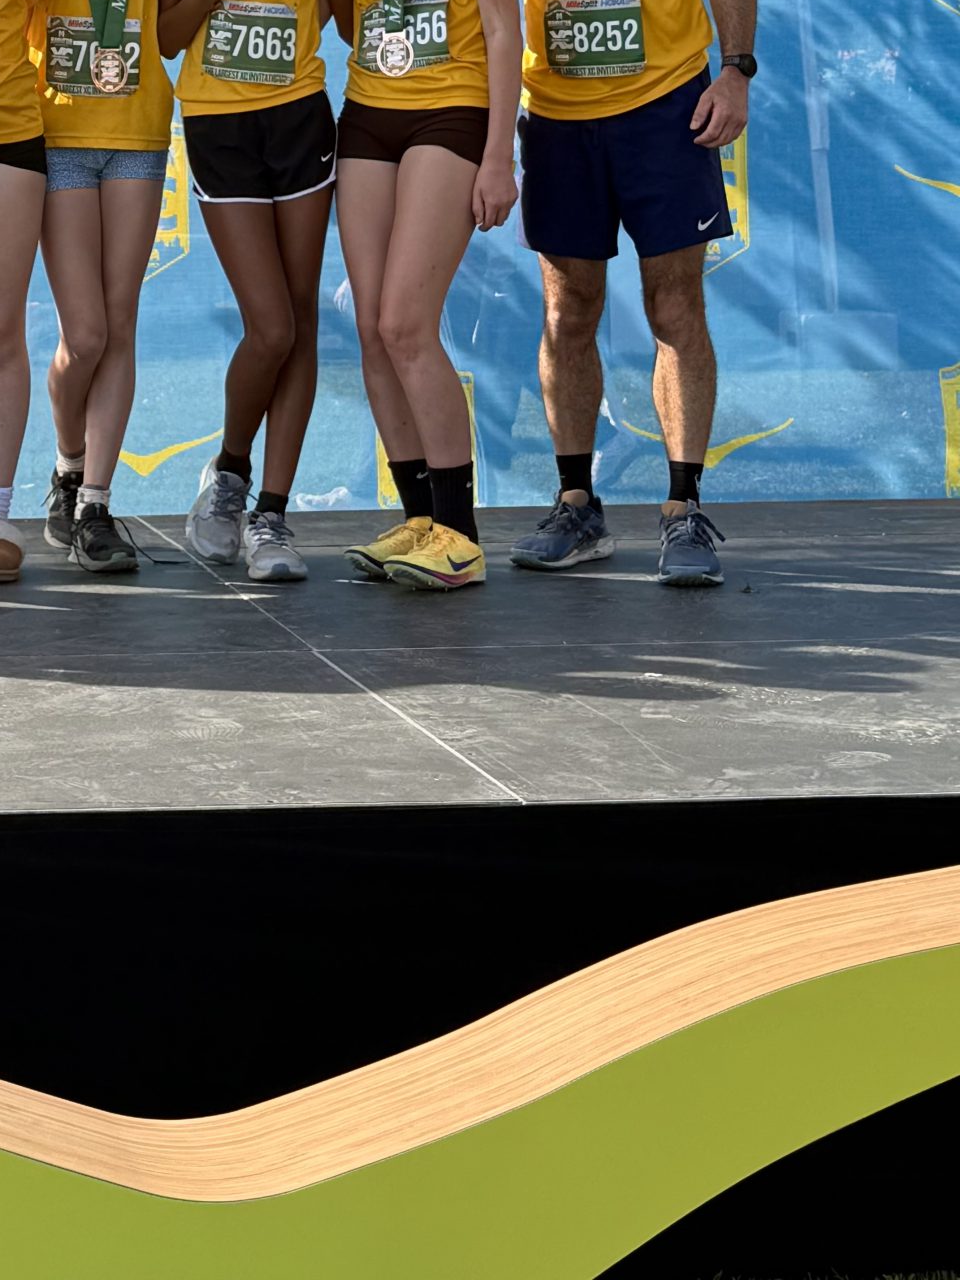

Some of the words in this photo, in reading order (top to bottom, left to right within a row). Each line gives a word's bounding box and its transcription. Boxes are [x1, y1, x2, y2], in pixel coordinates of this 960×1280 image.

[566, 0, 597, 9] MileSplit
[68, 20, 93, 29] MileSp
[404, 10, 447, 45] 656
[573, 19, 639, 52] 8252
[73, 40, 140, 73] 72
[233, 24, 296, 61] 7663
[240, 71, 247, 80] XC
